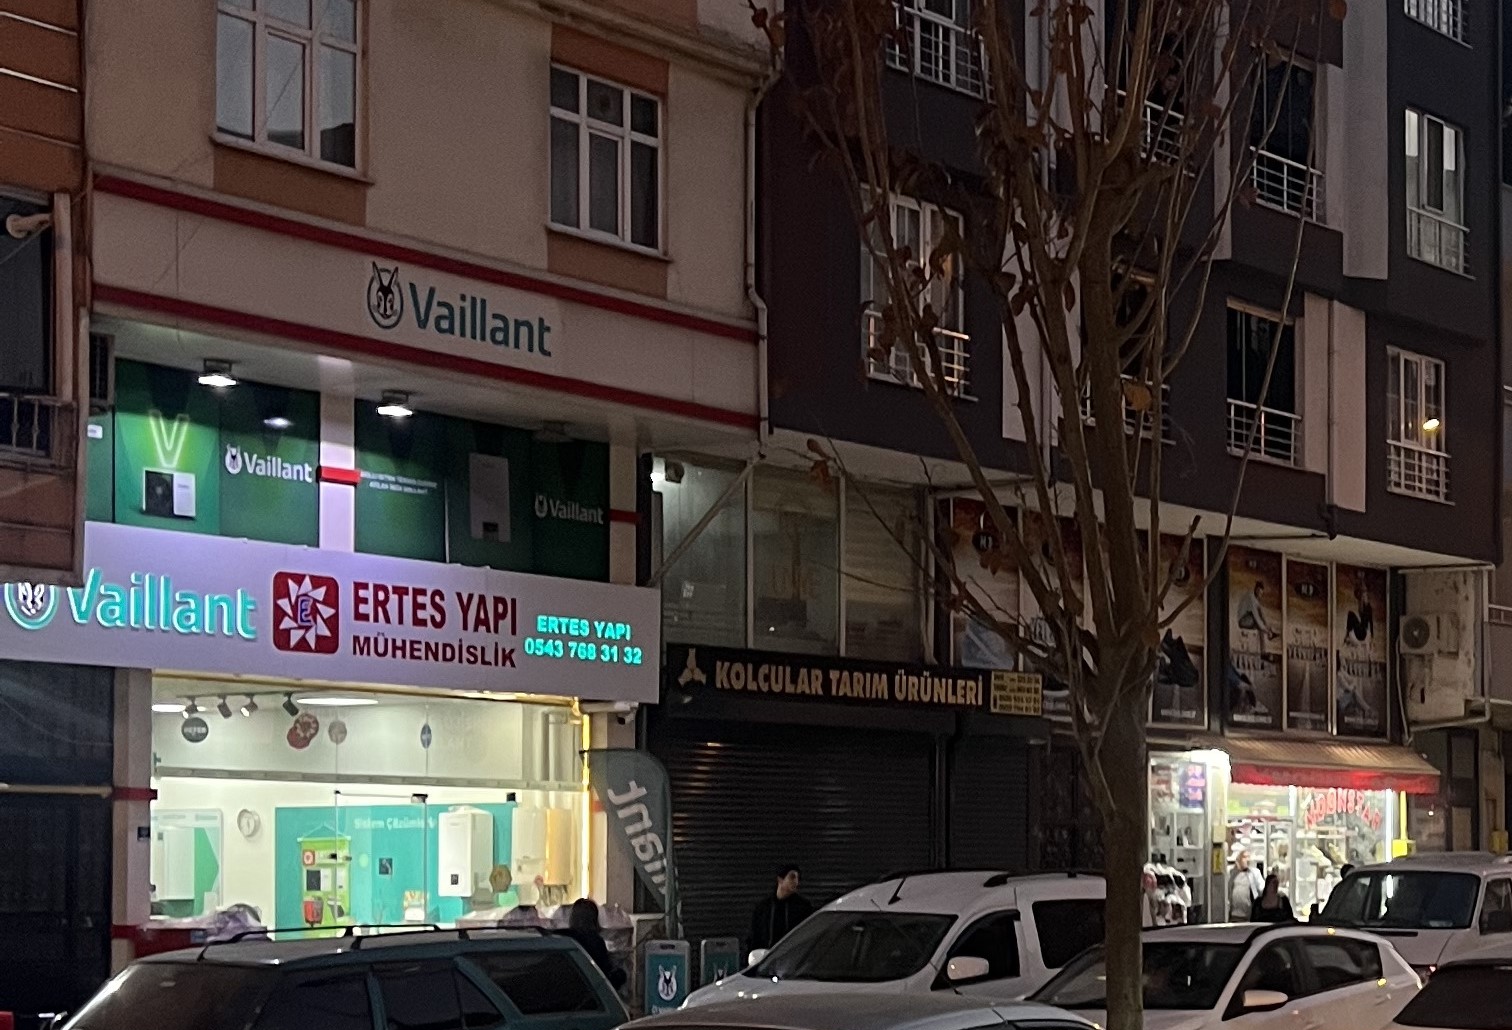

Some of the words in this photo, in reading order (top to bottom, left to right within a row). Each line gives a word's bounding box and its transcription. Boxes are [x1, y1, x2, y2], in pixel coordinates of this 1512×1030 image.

[409, 282, 552, 357] Vaillant
[244, 452, 313, 483] Vaillant
[550, 499, 604, 525] Vaillant
[67, 567, 258, 640] Vaillant
[353, 580, 446, 630] ERTES
[455, 590, 517, 636] YAPI
[536, 615, 590, 638] ERTES
[594, 620, 632, 642] YAPI
[352, 631, 517, 668] MÜHENDİSLİK
[524, 636, 564, 659] 0543
[568, 641, 596, 661] 768
[600, 643, 619, 663] 31
[623, 646, 643, 665] 32
[714, 659, 823, 695] KOLCULAR
[829, 668, 889, 700] TARIM
[894, 668, 984, 707] ÜRÜNLERİ
